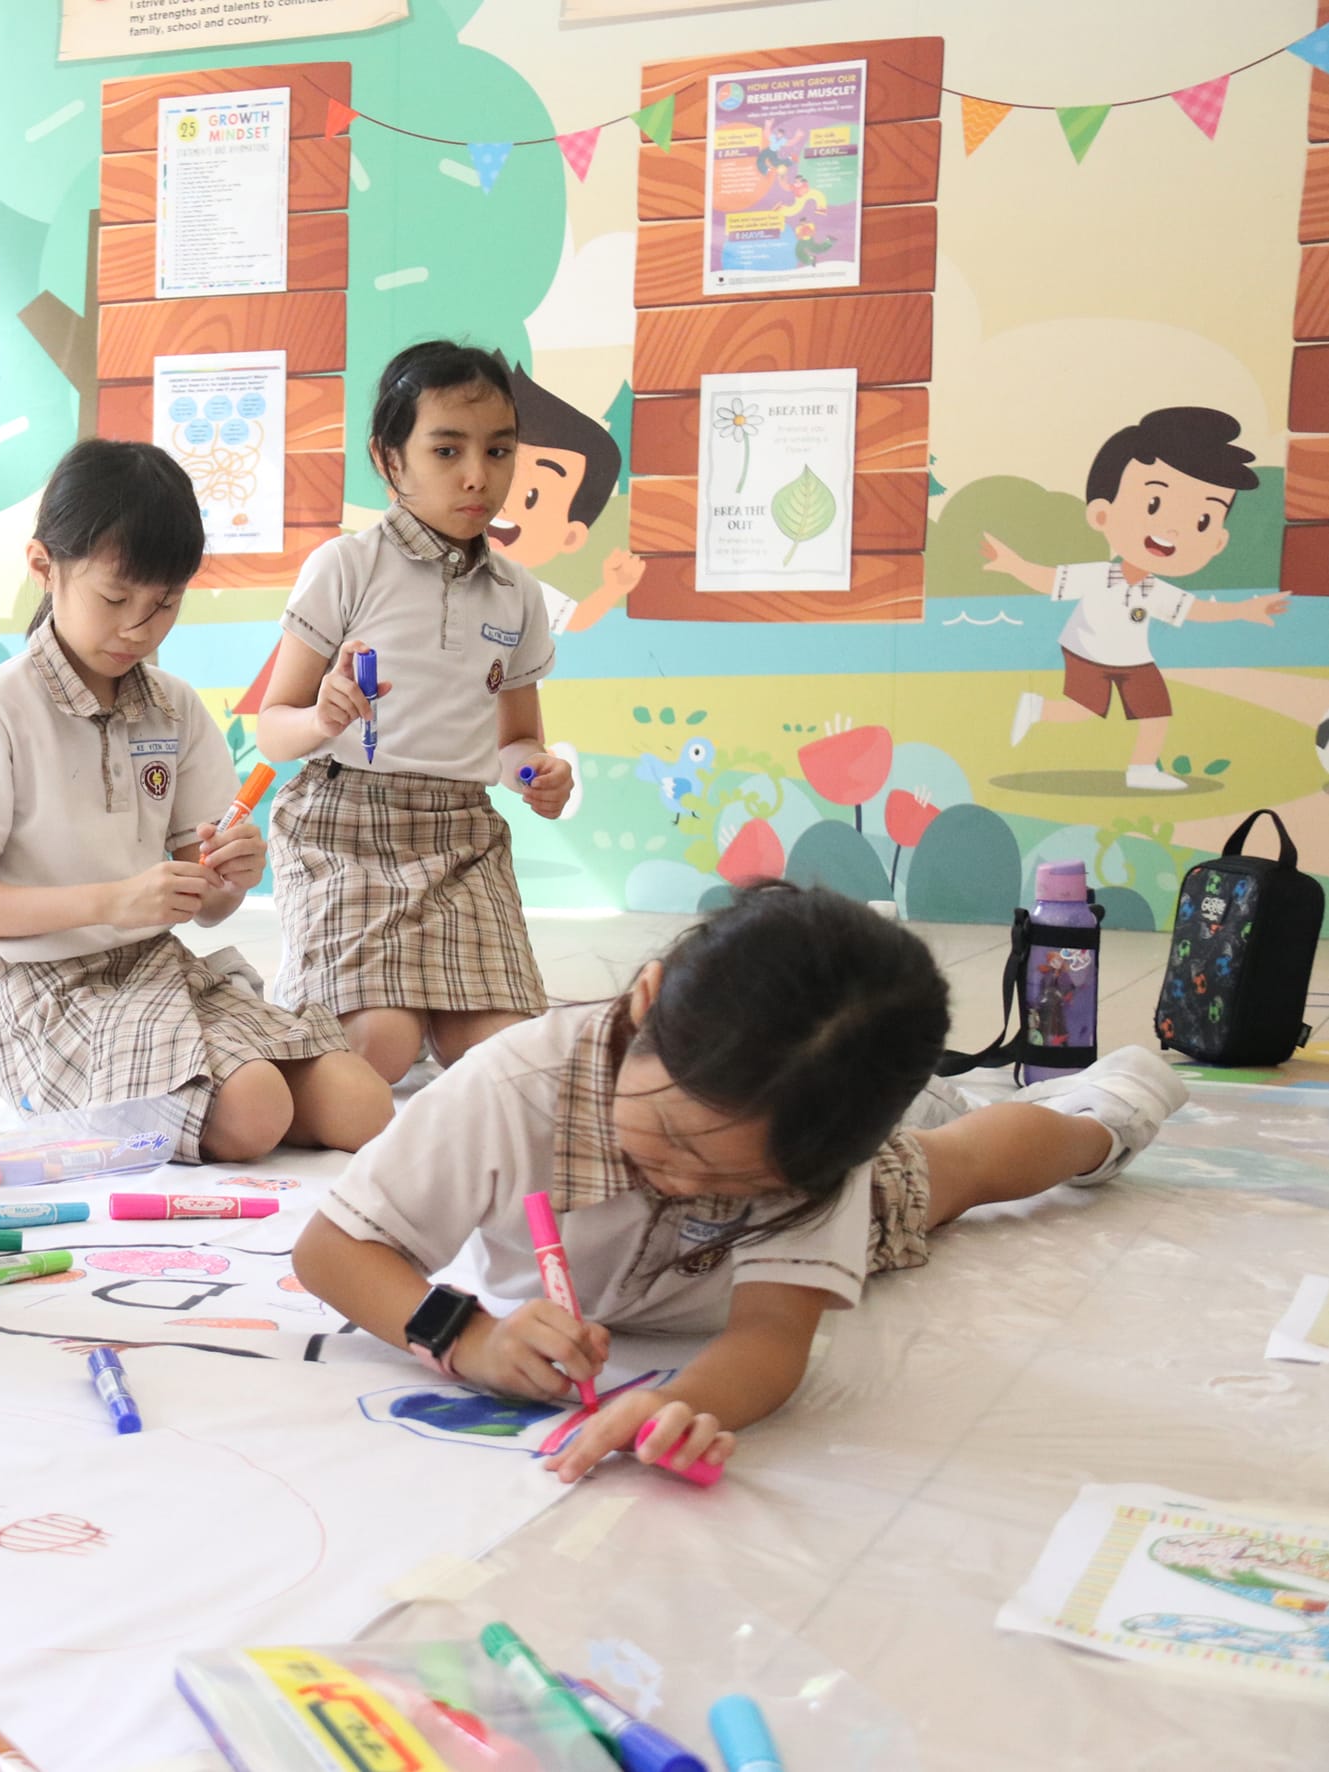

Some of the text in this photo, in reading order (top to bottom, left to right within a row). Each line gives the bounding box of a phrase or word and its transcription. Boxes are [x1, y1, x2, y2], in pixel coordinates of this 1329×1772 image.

[129, 15, 145, 23] my
[148, 8, 197, 21] strengths
[200, 5, 220, 15] and
[223, 1, 261, 13] talents
[129, 15, 273, 37] family, school and country.
[746, 74, 857, 91] HOW CAN WE GROW OUR
[746, 85, 857, 105] RESILIENCE MUSCLE?
[179, 110, 270, 138] 25 GROWTH
[208, 126, 270, 142] MINDSET
[768, 404, 838, 417] BREATHE IN
[713, 504, 767, 517] BREATHE
[727, 519, 753, 531] OUT
